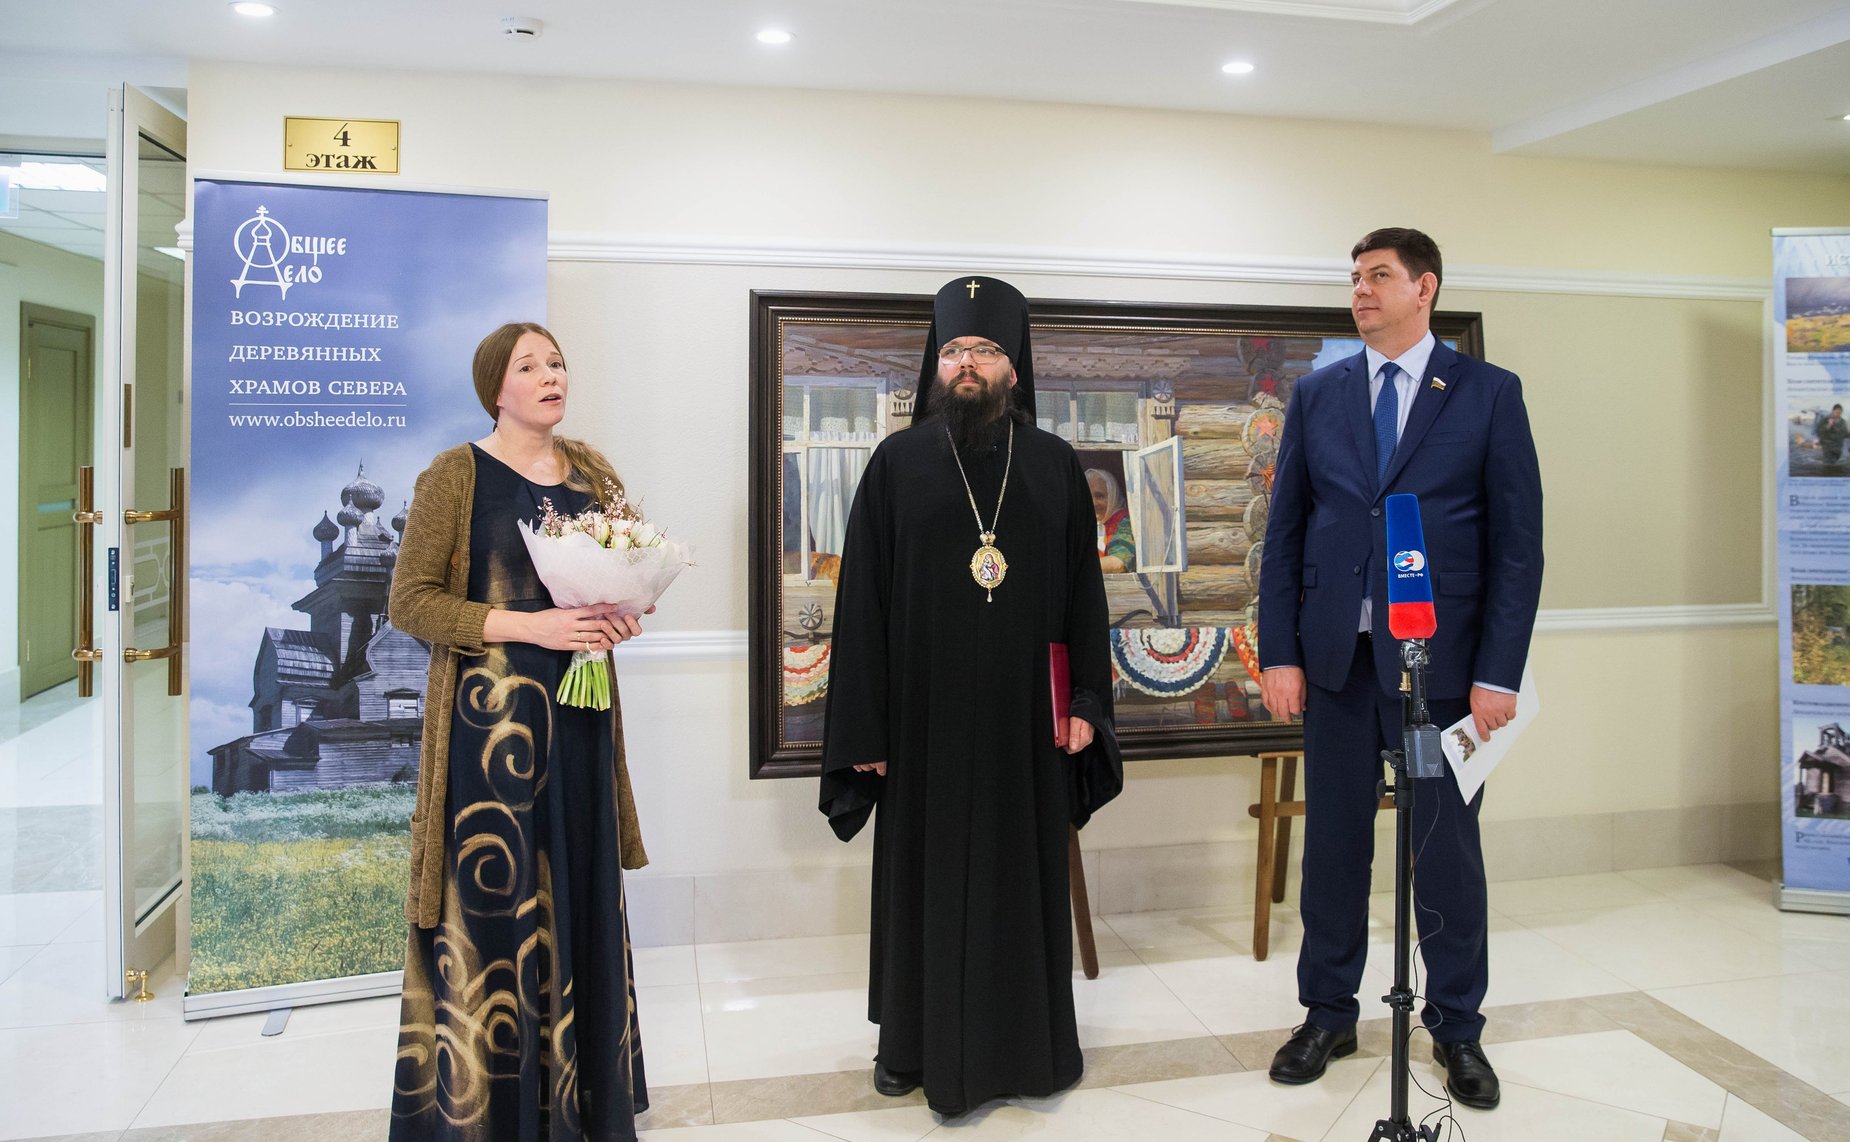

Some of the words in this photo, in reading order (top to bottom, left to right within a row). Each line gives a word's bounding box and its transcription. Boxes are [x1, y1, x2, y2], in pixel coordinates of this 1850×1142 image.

[333, 122, 352, 147] 4
[305, 153, 378, 170] этаж
[230, 310, 399, 330] ВОЗРОЖДЕНИЕ
[229, 345, 382, 362] ДЕРЕВЯННЫХ
[229, 380, 321, 395] ХРАМОВ
[328, 381, 407, 396] СЕВЕРА
[229, 411, 407, 427] www.obsheedelo.ru
